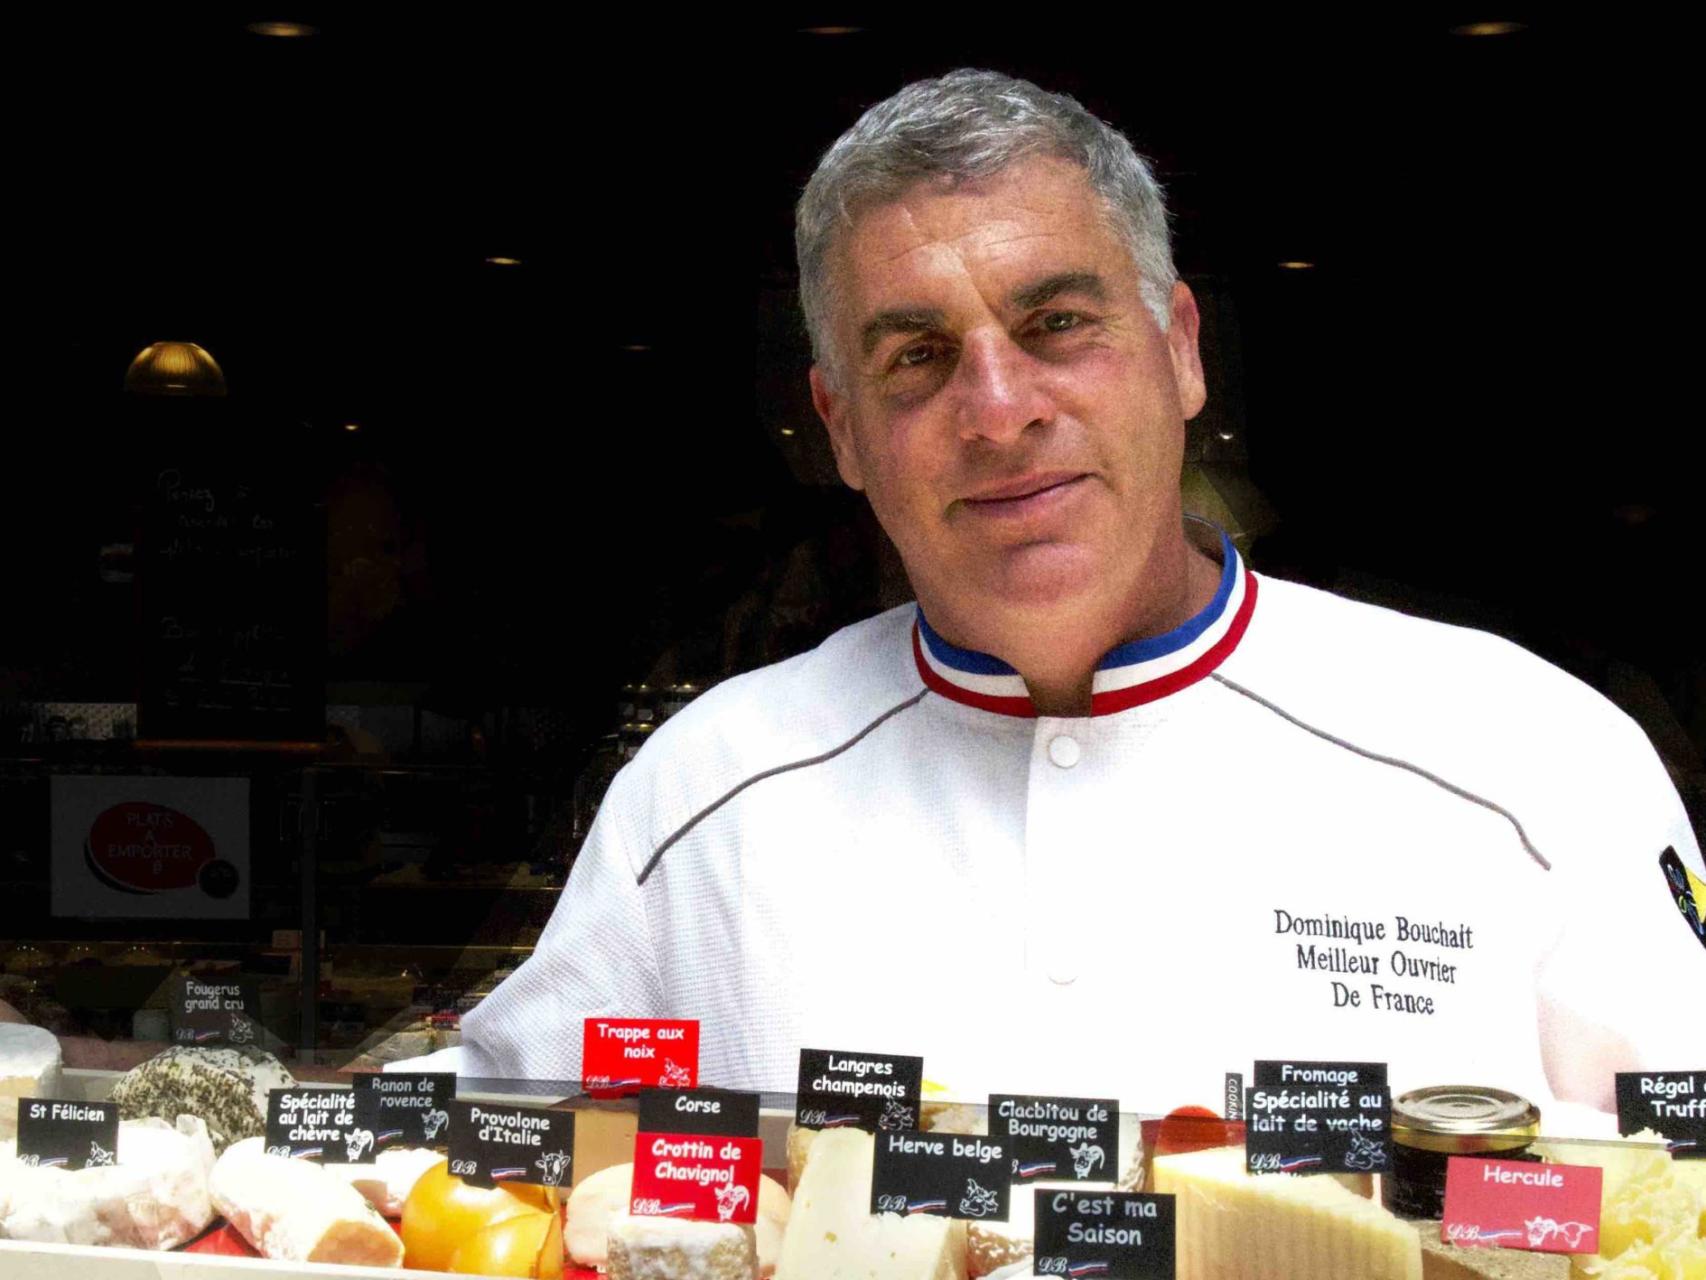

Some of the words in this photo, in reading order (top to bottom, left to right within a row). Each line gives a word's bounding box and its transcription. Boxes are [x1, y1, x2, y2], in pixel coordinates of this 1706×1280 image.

[125, 811, 175, 826] PLATS
[1274, 908, 1387, 946] Dominique
[1395, 915, 1474, 950] Bouchait
[1296, 943, 1380, 976] Meilleur
[1391, 949, 1457, 985] Ouvrier
[185, 980, 241, 999] Fougerus
[1331, 981, 1361, 1009] De
[1370, 983, 1435, 1015] France
[184, 996, 220, 1014] grand
[223, 999, 245, 1010] cru
[597, 1023, 651, 1043] Trappe
[656, 1028, 685, 1040] aux
[623, 1044, 656, 1059] noix
[828, 1054, 894, 1077] Langres
[1281, 1064, 1359, 1087] Fromage
[417, 1076, 435, 1092] de
[812, 1074, 906, 1098] champenois
[1640, 1075, 1695, 1100] Régal
[29, 1103, 48, 1119] St
[51, 1103, 105, 1122] Félicien
[280, 1092, 356, 1113] Spécialité
[674, 1095, 721, 1113] Corse
[998, 1099, 1080, 1121] Clacbitou
[1086, 1103, 1109, 1122] de
[1252, 1089, 1351, 1114] Spécialité
[1358, 1094, 1383, 1109] au
[278, 1112, 298, 1126] au
[302, 1109, 330, 1126] lait
[334, 1109, 354, 1126] de
[470, 1106, 551, 1131] Provolone
[1252, 1113, 1286, 1132] lait
[1294, 1114, 1318, 1132] de
[1325, 1112, 1384, 1132] vache
[288, 1124, 341, 1142] chèvre
[478, 1126, 542, 1146] d'Italie
[1007, 1118, 1099, 1143] Bourgogne
[651, 1138, 714, 1159] Crottin
[719, 1141, 742, 1160] de
[888, 1134, 945, 1156] Herve
[952, 1138, 1003, 1164] belge
[654, 1161, 735, 1186] Chavignol
[1483, 1164, 1564, 1188] Hercule
[1051, 1192, 1115, 1216] C'est
[1124, 1200, 1158, 1218] ma
[1066, 1222, 1142, 1246] Saison
